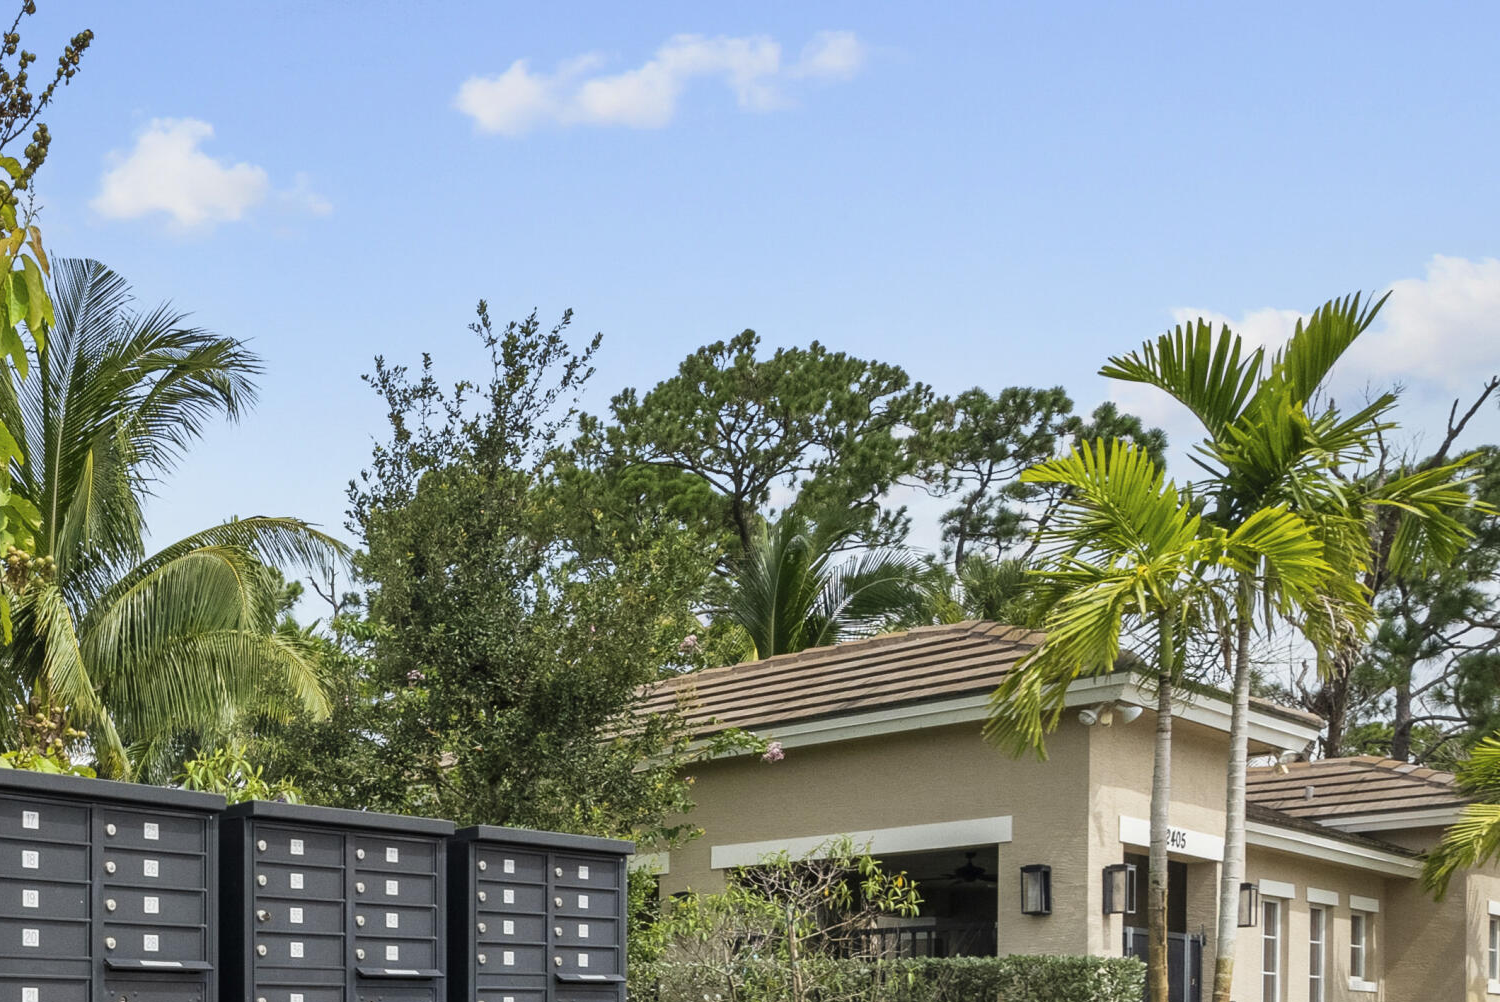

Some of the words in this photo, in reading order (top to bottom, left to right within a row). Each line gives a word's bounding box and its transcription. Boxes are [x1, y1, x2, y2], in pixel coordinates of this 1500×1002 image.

[26, 814, 36, 827] 17
[1166, 829, 1186, 849] 2405
[26, 853, 36, 866] 18
[146, 862, 157, 875] 26
[26, 892, 36, 905] 19
[146, 898, 157, 912] 27
[24, 931, 37, 945] 20
[146, 936, 157, 949] 28
[26, 990, 36, 1002] 21
